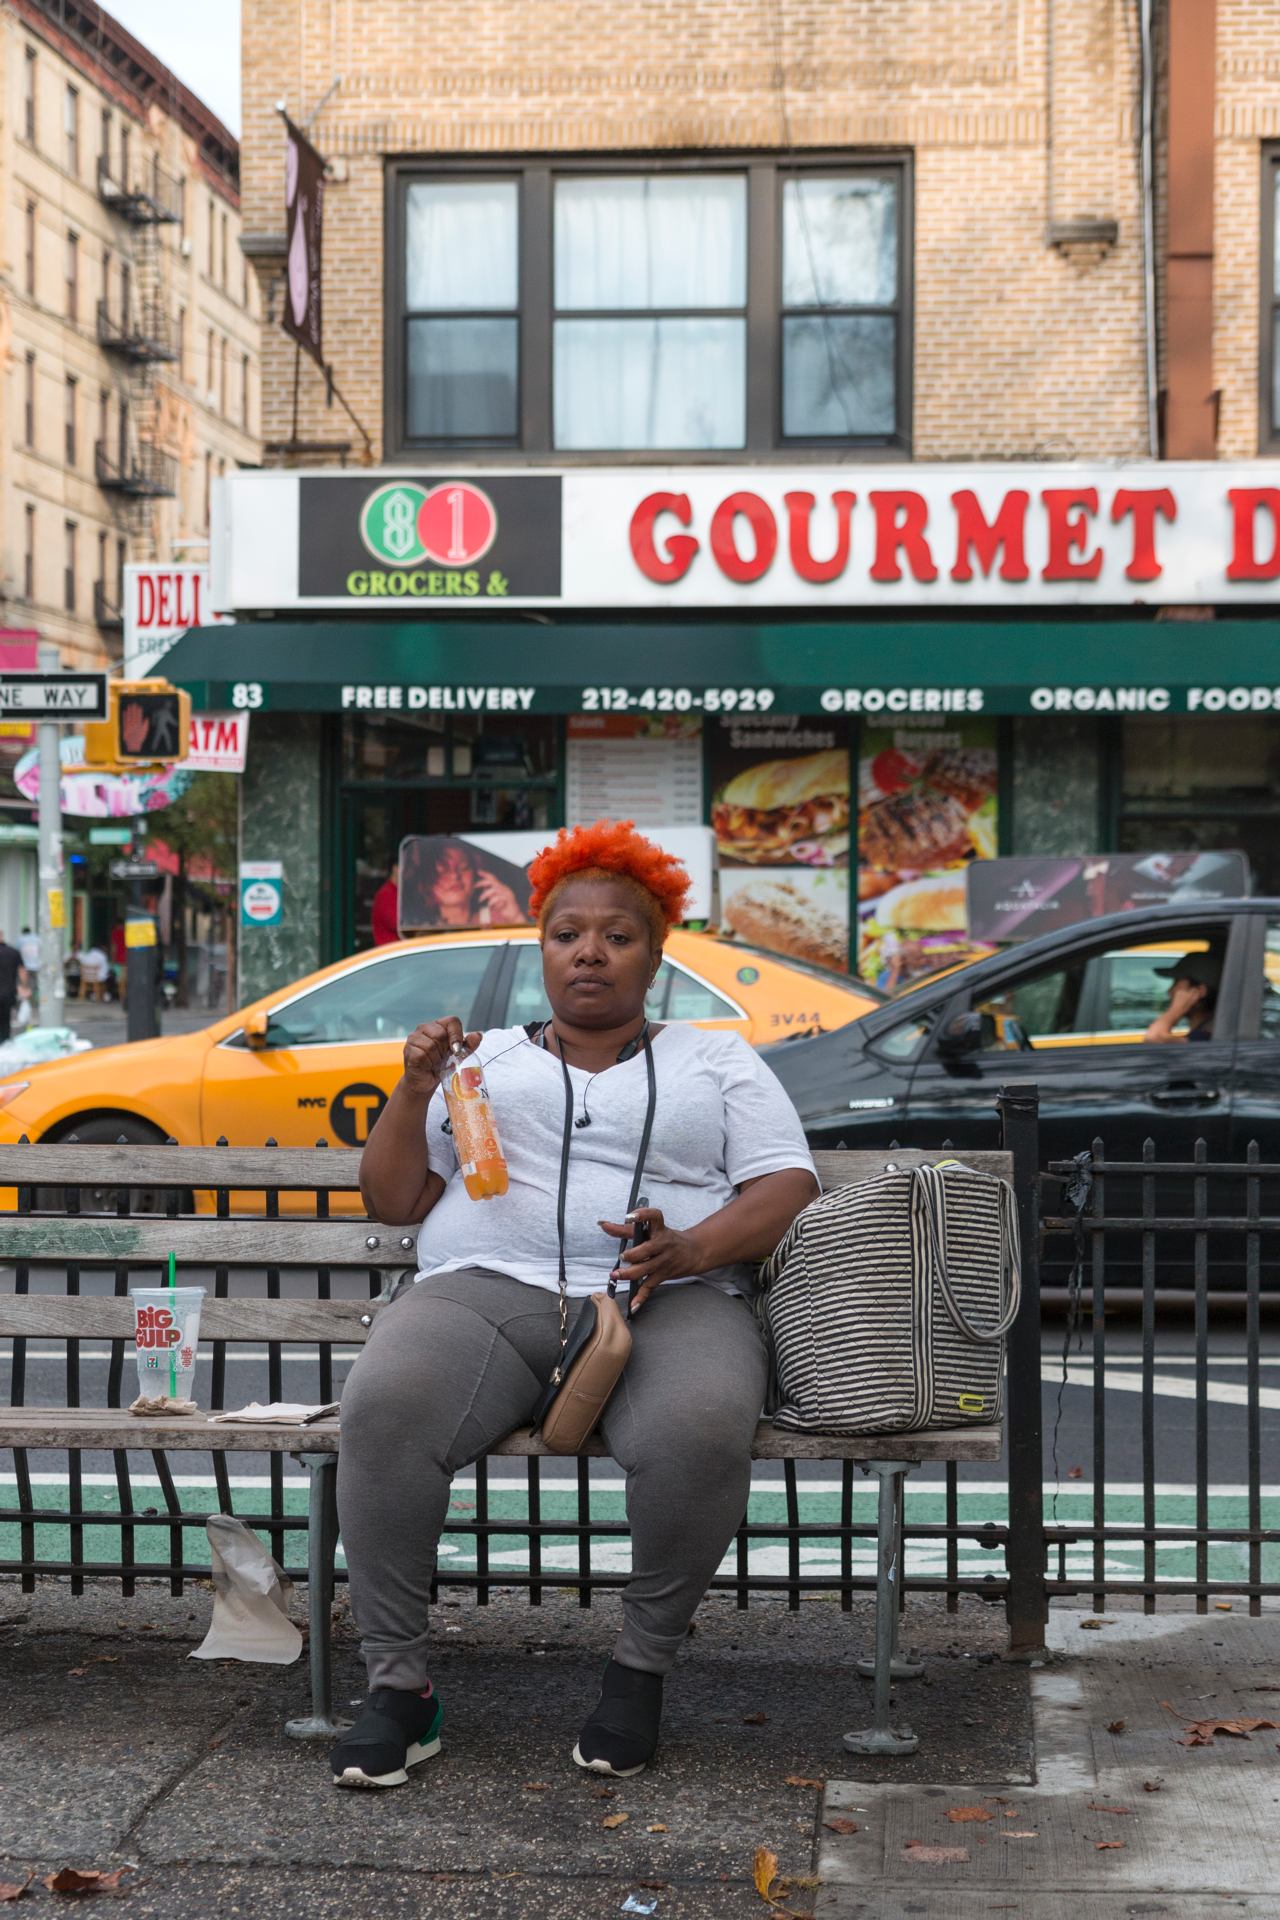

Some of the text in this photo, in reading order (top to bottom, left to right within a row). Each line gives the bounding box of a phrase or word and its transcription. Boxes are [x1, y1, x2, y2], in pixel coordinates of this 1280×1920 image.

[629, 487, 1177, 583] GOURMET
[347, 570, 509, 596] GROCERS &
[137, 574, 201, 628] DELI
[44, 689, 88, 706] WAY
[232, 683, 263, 708] 83
[341, 686, 535, 709] FREE DELIVERY
[582, 688, 775, 711] 212-420-5929
[820, 688, 984, 711] GROCERIES
[1030, 687, 1170, 711] ORGANIC
[770, 1013, 820, 1026] 3V44
[297, 1097, 327, 1109] NYC
[136, 1328, 181, 1348] GULP
